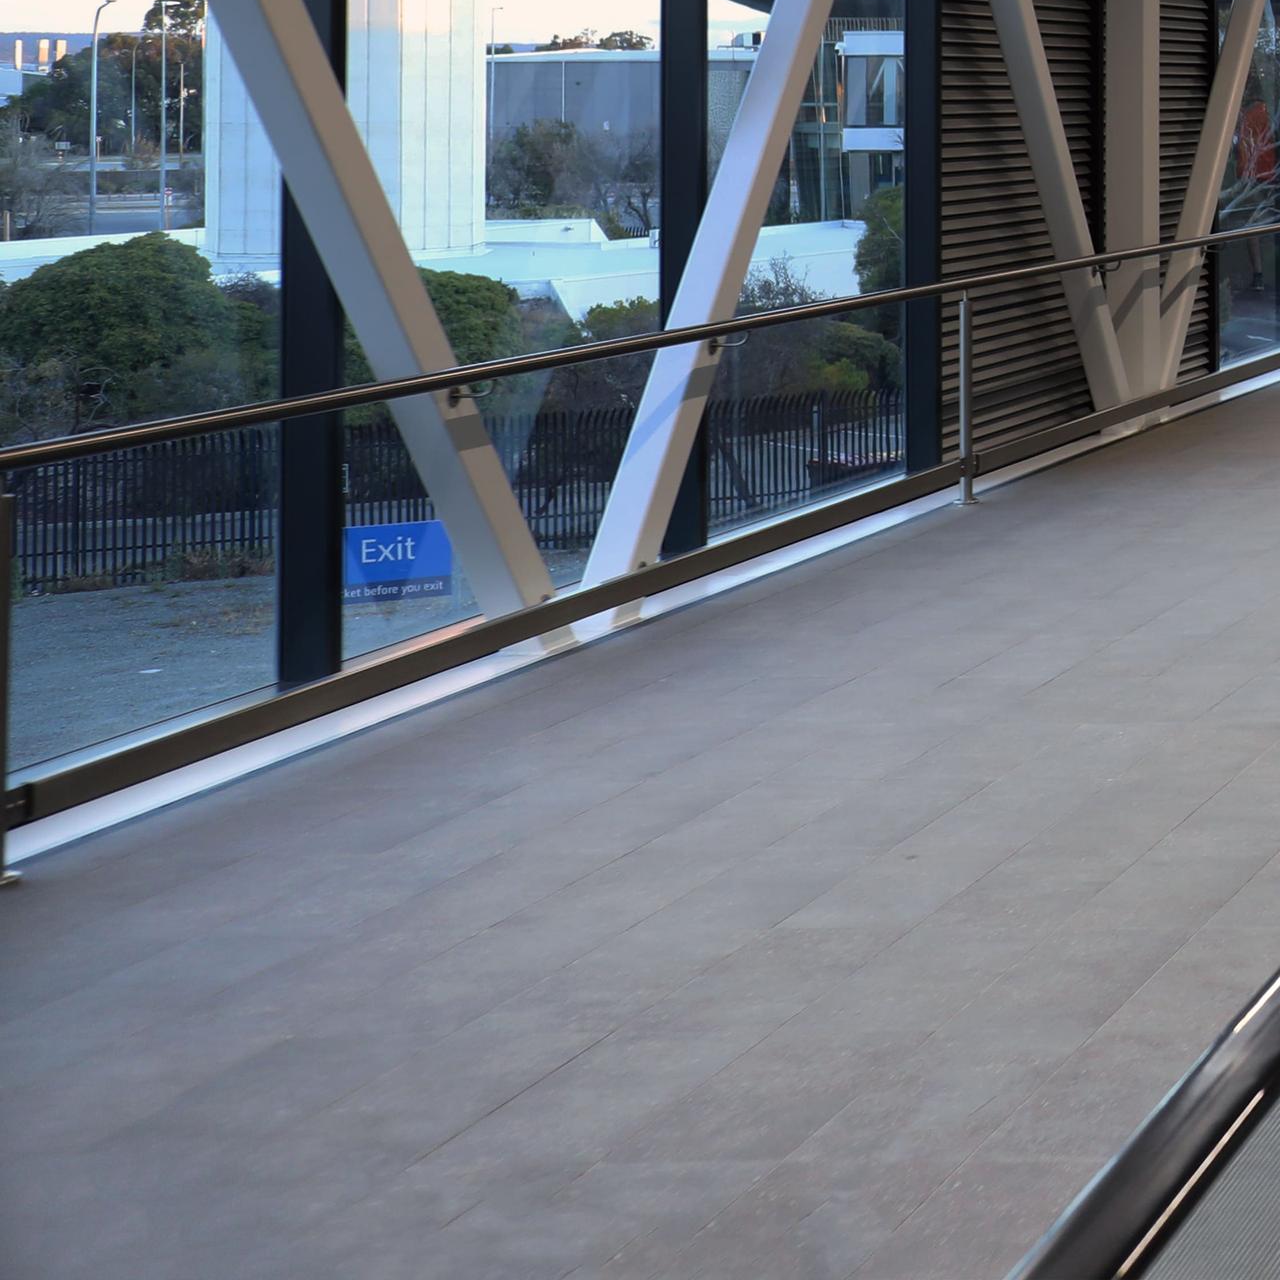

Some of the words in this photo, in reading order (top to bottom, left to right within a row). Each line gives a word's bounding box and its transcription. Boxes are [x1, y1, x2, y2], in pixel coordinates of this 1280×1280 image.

[361, 537, 416, 564] Exit
[343, 588, 361, 598] ket
[364, 584, 399, 597] before
[401, 584, 420, 596] you
[423, 581, 443, 591] exit
